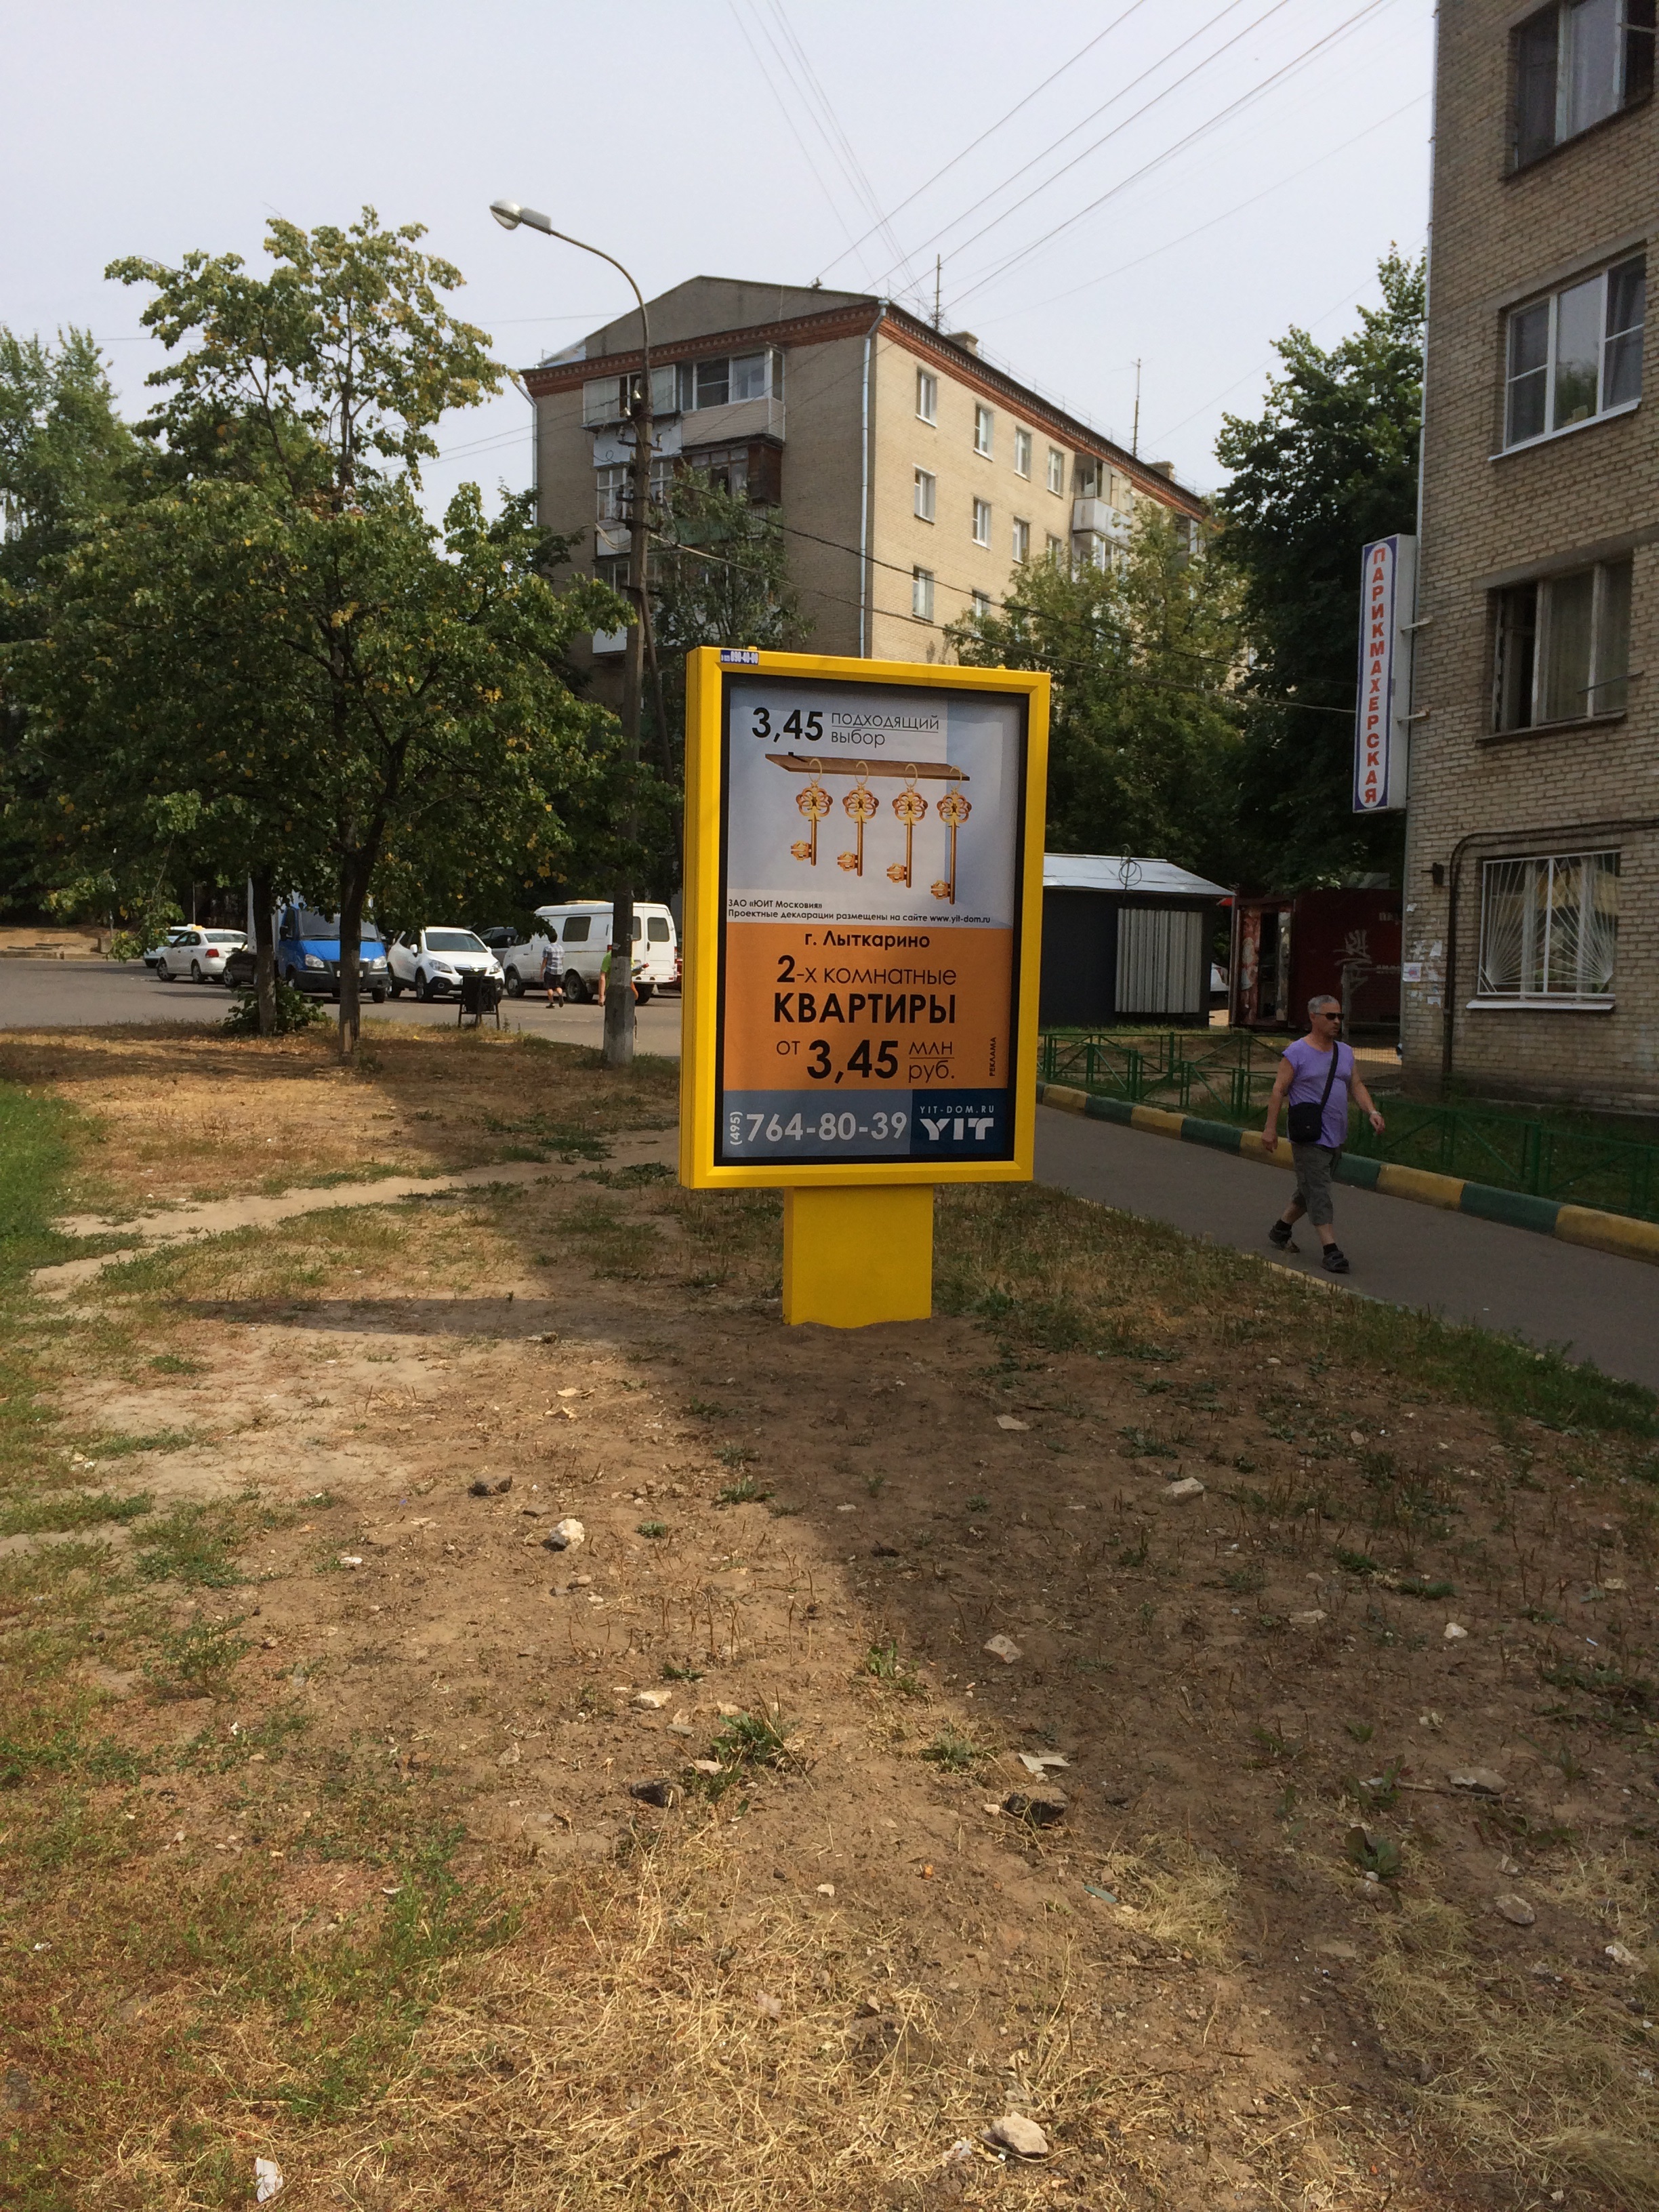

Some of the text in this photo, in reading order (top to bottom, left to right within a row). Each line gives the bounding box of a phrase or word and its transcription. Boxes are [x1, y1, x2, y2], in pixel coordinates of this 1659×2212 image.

[1364, 547, 1386, 804] ПАРИКМАХЕРСКАЯ
[752, 708, 940, 743] 3,45 подходящий
[831, 730, 885, 748] выбор
[728, 899, 822, 909] ЗАО «ЮИТ Московия»
[728, 909, 779, 918] Проектные
[781, 912, 834, 920] декларации
[836, 913, 888, 921] размещены
[902, 914, 927, 922] сайте
[929, 915, 991, 924] www.yit-dom.ru
[804, 930, 930, 950] г. Лыткарино
[777, 955, 956, 985] 2-х комнатные
[774, 992, 956, 1023] КВАРТИРЫ
[776, 1040, 953, 1084] от 3,45 млн
[989, 1037, 997, 1077] РЕКЛАМА
[909, 1060, 955, 1083] руб.
[920, 1105, 994, 1113] YIT-DOM.RU
[730, 1111, 907, 1145] (495) 764-80-39
[919, 1118, 994, 1141] YIT
